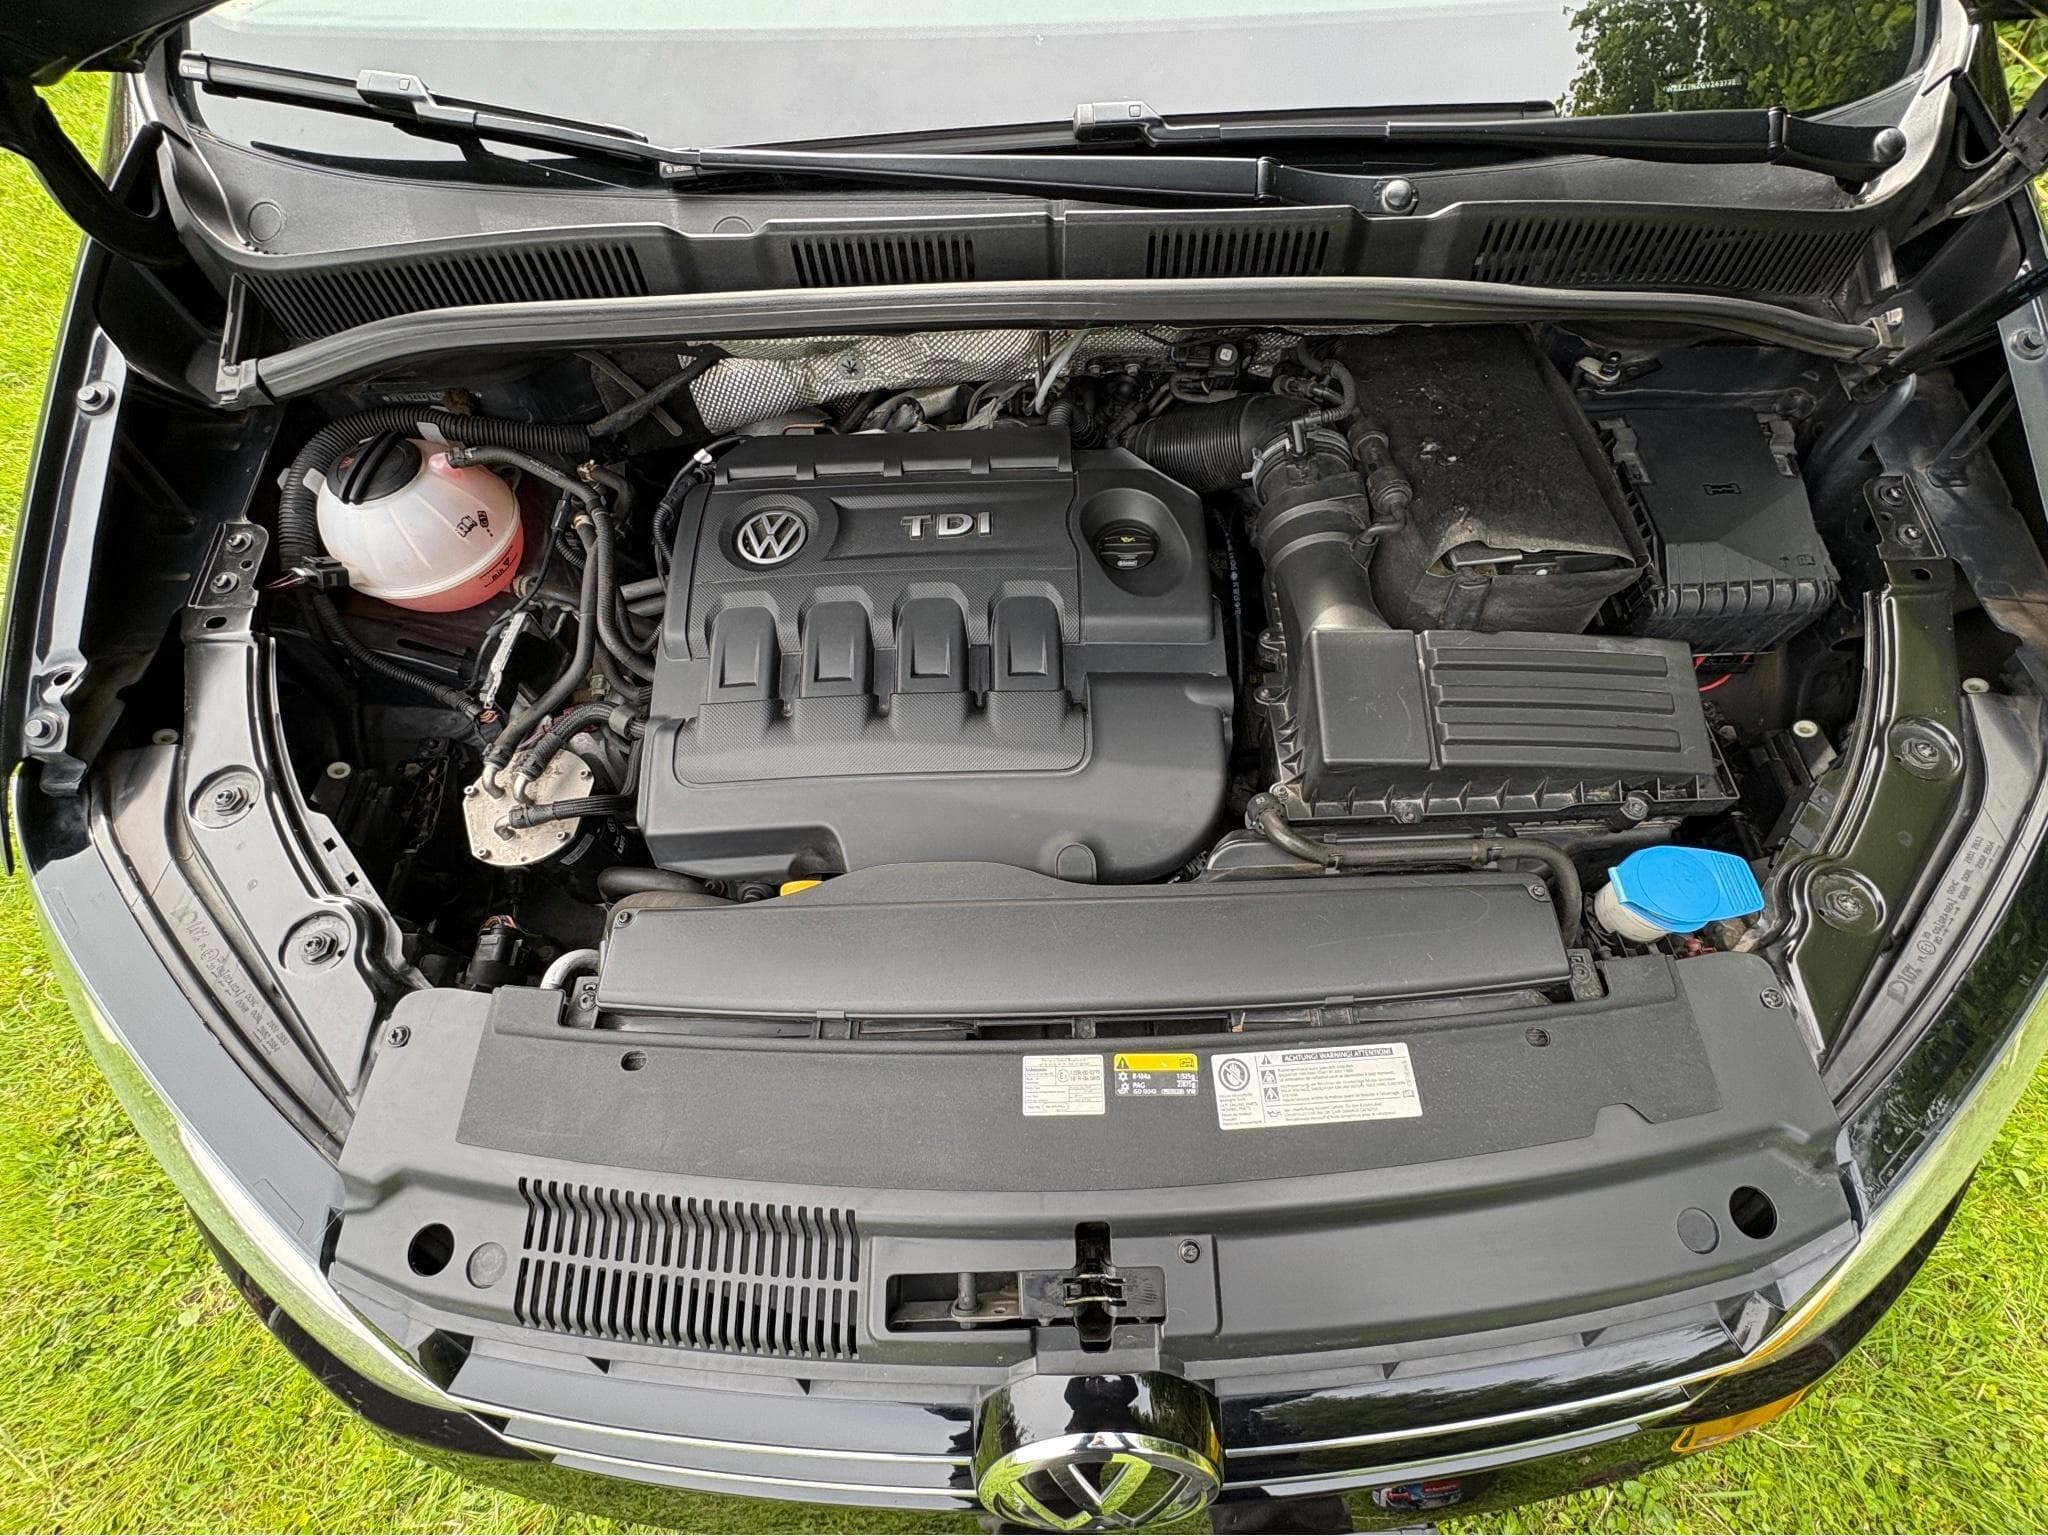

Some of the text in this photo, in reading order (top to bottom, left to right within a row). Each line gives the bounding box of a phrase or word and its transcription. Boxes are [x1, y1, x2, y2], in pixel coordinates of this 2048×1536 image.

[738, 511, 806, 564] VW
[901, 511, 993, 540] TDI
[491, 568, 505, 581] min
